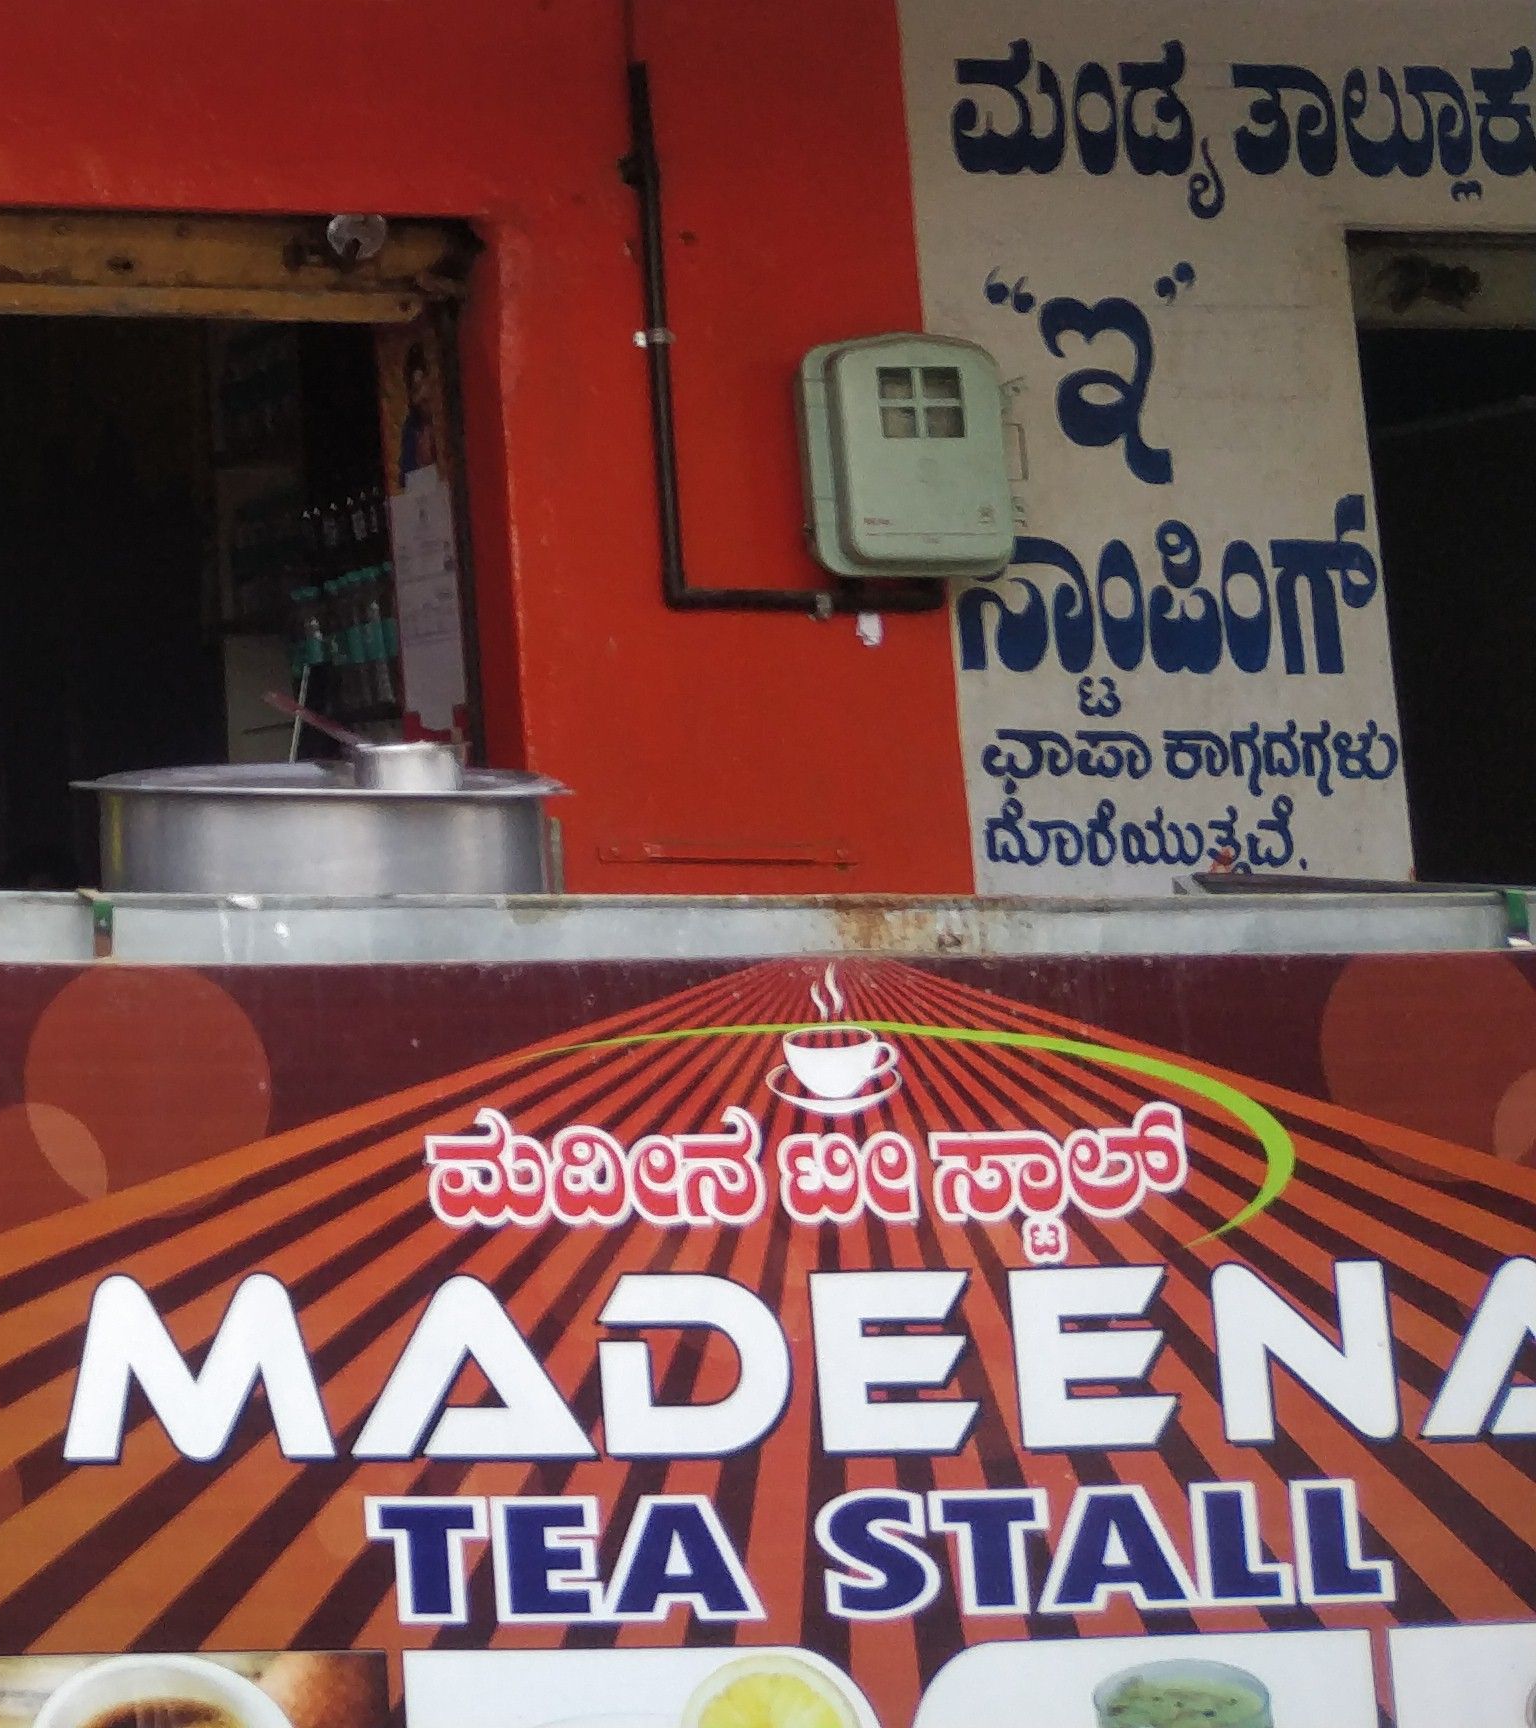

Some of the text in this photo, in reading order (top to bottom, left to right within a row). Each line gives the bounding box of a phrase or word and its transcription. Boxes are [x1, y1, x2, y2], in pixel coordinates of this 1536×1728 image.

[950, 38, 1226, 220] ಮಂಡ್ಯ
[424, 1100, 1189, 1264] ಮದೀನ ಟೀ ಸ್ಟಾಲ್
[364, 1476, 1397, 1626] TEA STALL
